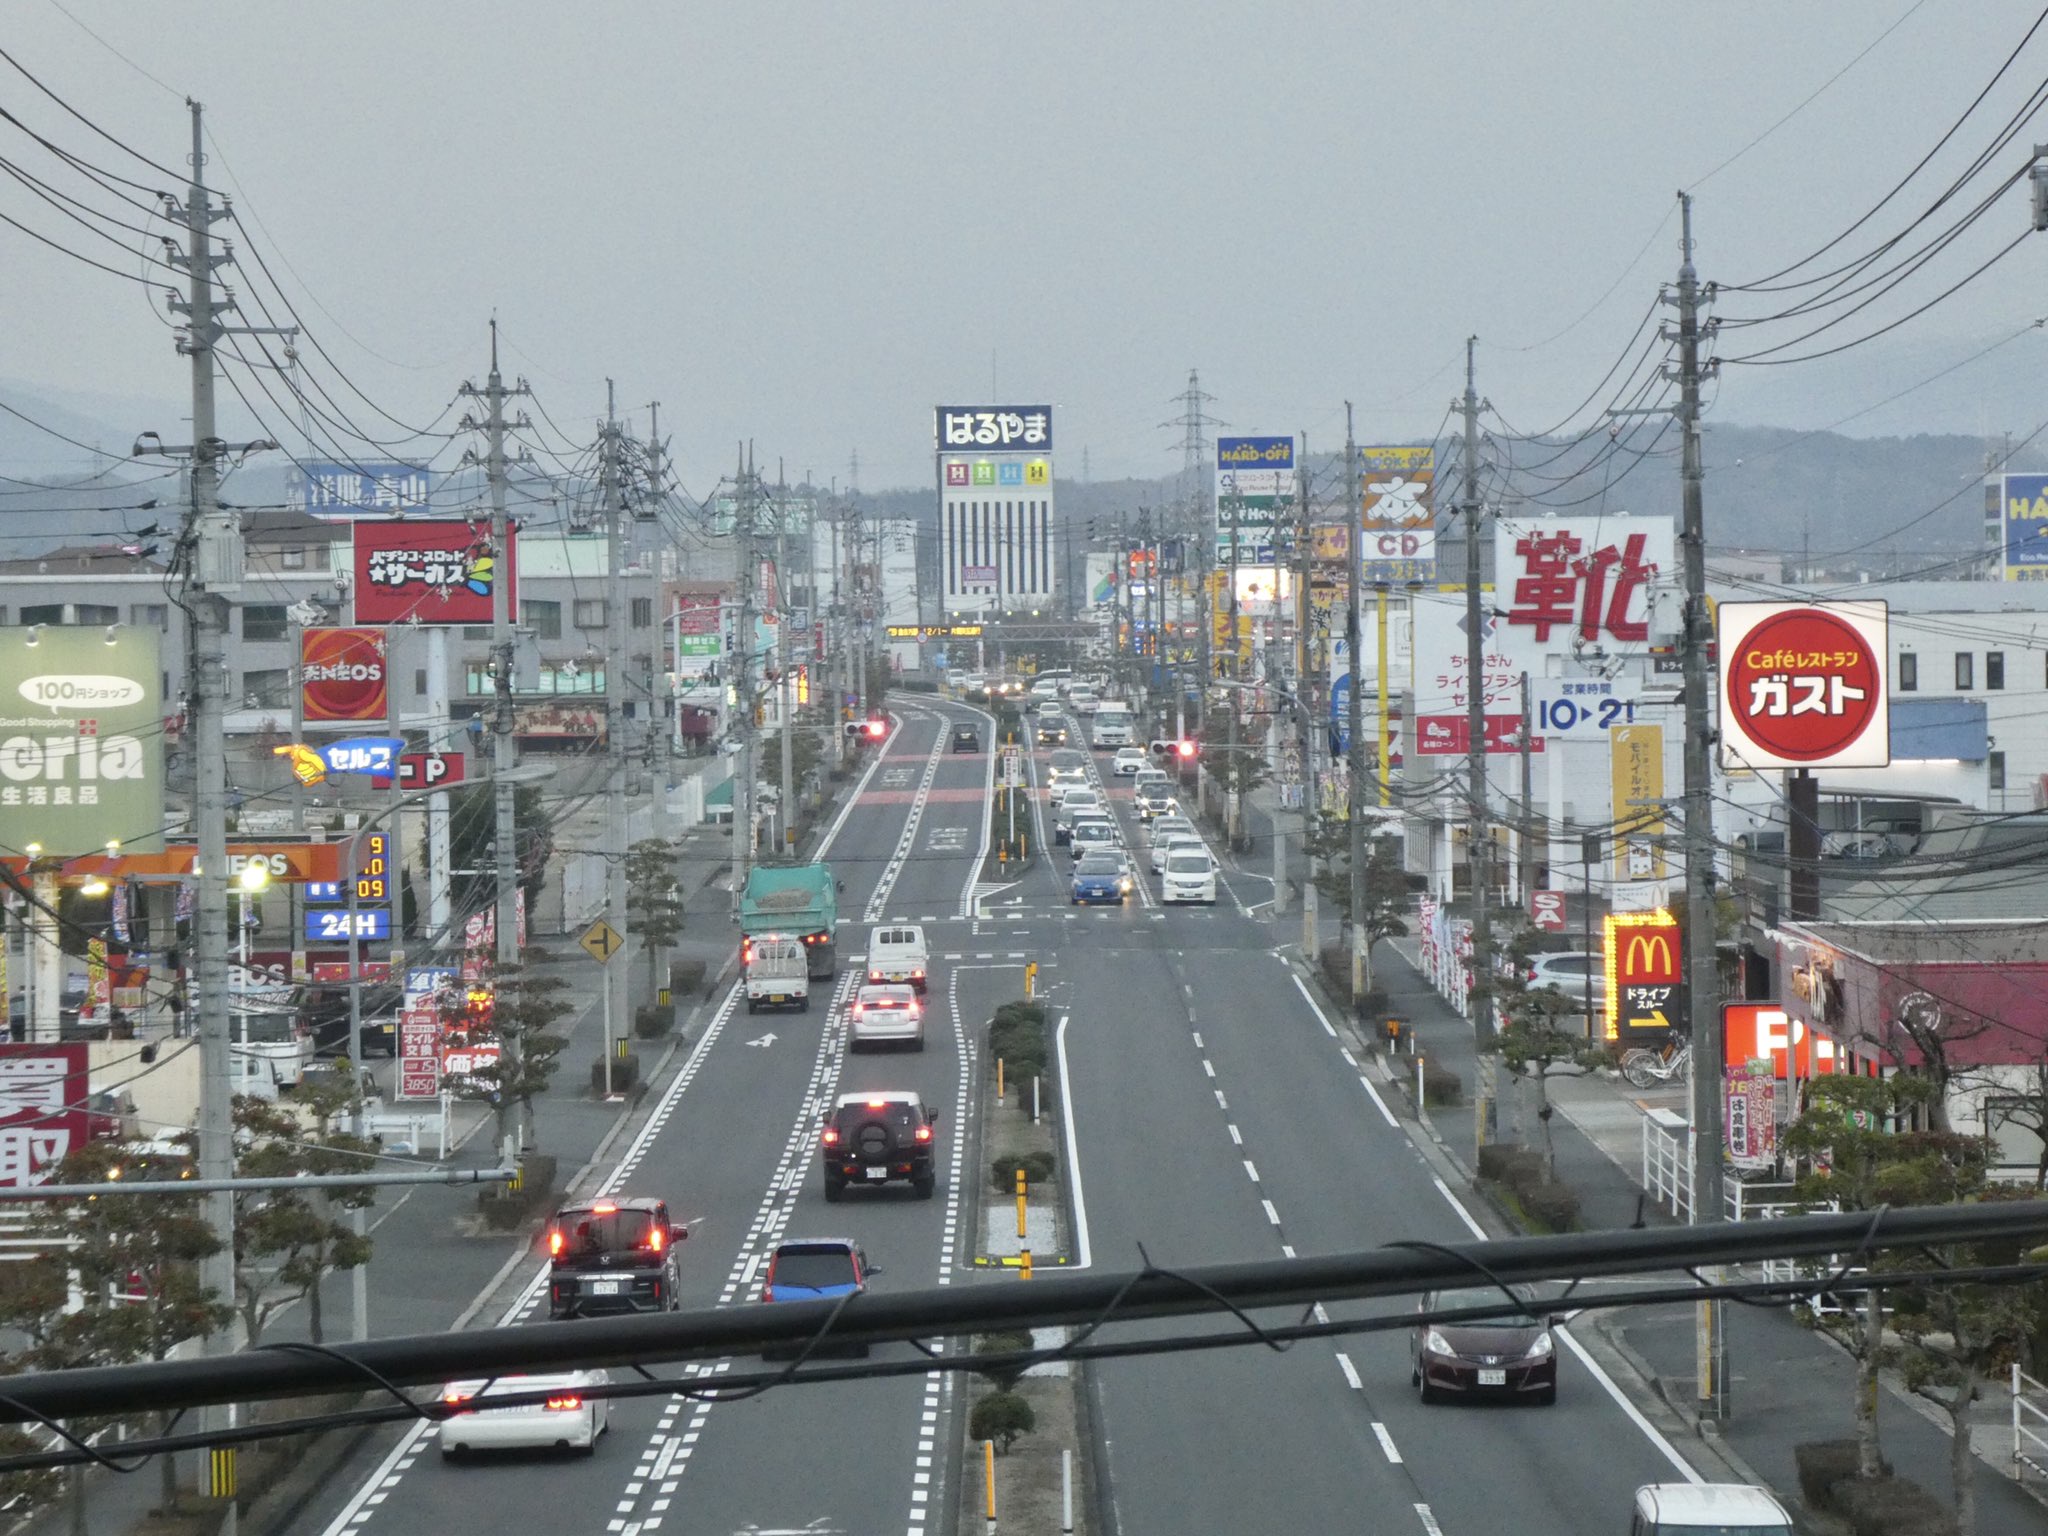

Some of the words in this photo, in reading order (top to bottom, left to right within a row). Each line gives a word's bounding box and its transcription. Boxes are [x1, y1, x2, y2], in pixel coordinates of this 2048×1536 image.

[946, 413, 1047, 444] はるやま
[310, 473, 427, 507] 洋服の青山
[1377, 534, 1419, 556] CD
[385, 563, 466, 584] サーカス
[1508, 530, 1658, 642] 靴
[1450, 653, 1512, 668] ちぎん
[36, 682, 132, 699] 100円ショップ
[1562, 683, 1612, 695] 営業時間
[1749, 674, 1865, 718] ガスト
[1452, 692, 1512, 707] セター
[0, 717, 26, 728] Good
[27, 717, 76, 729] Shopping
[1540, 699, 1577, 730] 10
[327, 747, 391, 770] セルフ
[2, 786, 98, 805] 生活良品
[321, 914, 376, 936] 24H
[1627, 987, 1671, 999] ドライブ
[1637, 1000, 1664, 1009] スルー
[404, 1033, 435, 1045] オイル
